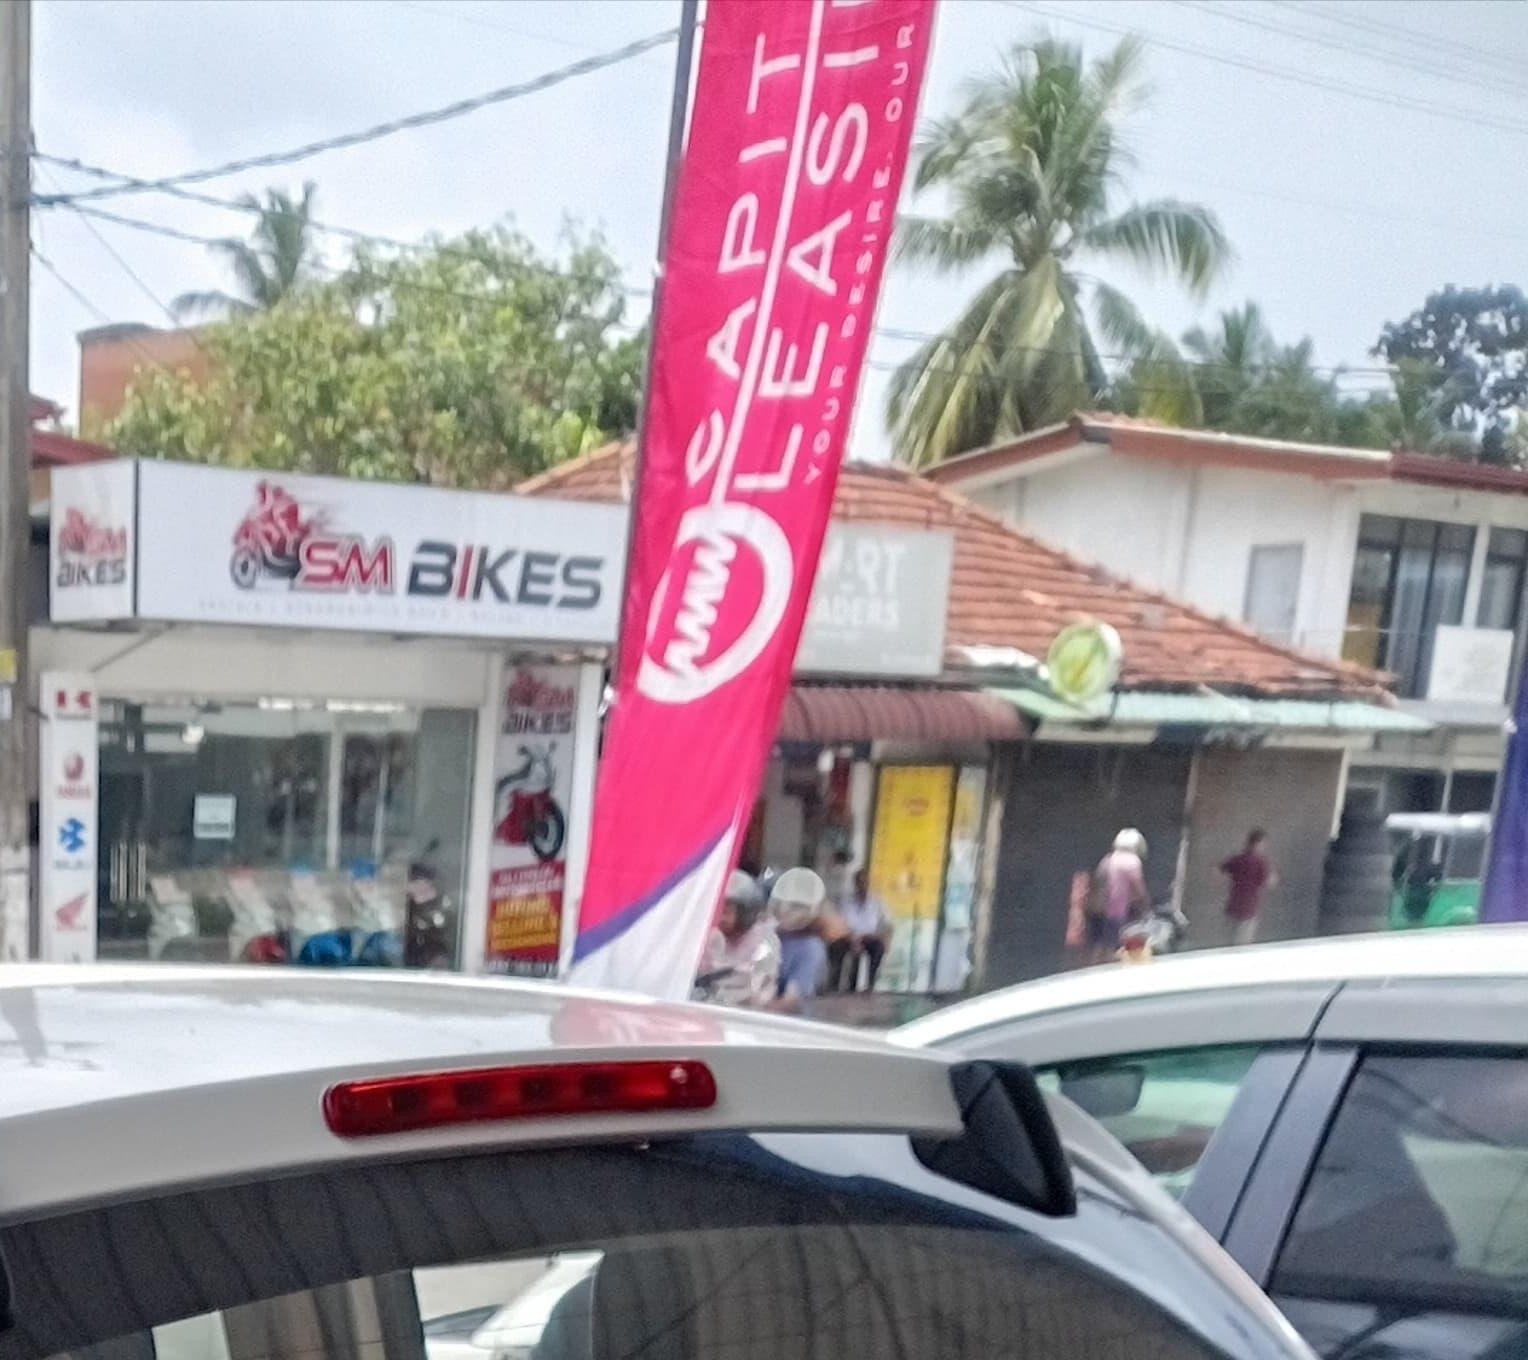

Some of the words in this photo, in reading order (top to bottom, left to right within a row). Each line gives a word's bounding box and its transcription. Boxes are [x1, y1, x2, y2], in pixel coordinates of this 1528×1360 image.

[732, 0, 879, 491] LEASI
[803, 364, 847, 485] YOUR
[885, 23, 915, 123] OUR
[57, 559, 128, 588] BIKES
[297, 535, 394, 596] SM
[406, 538, 606, 609] BIKES
